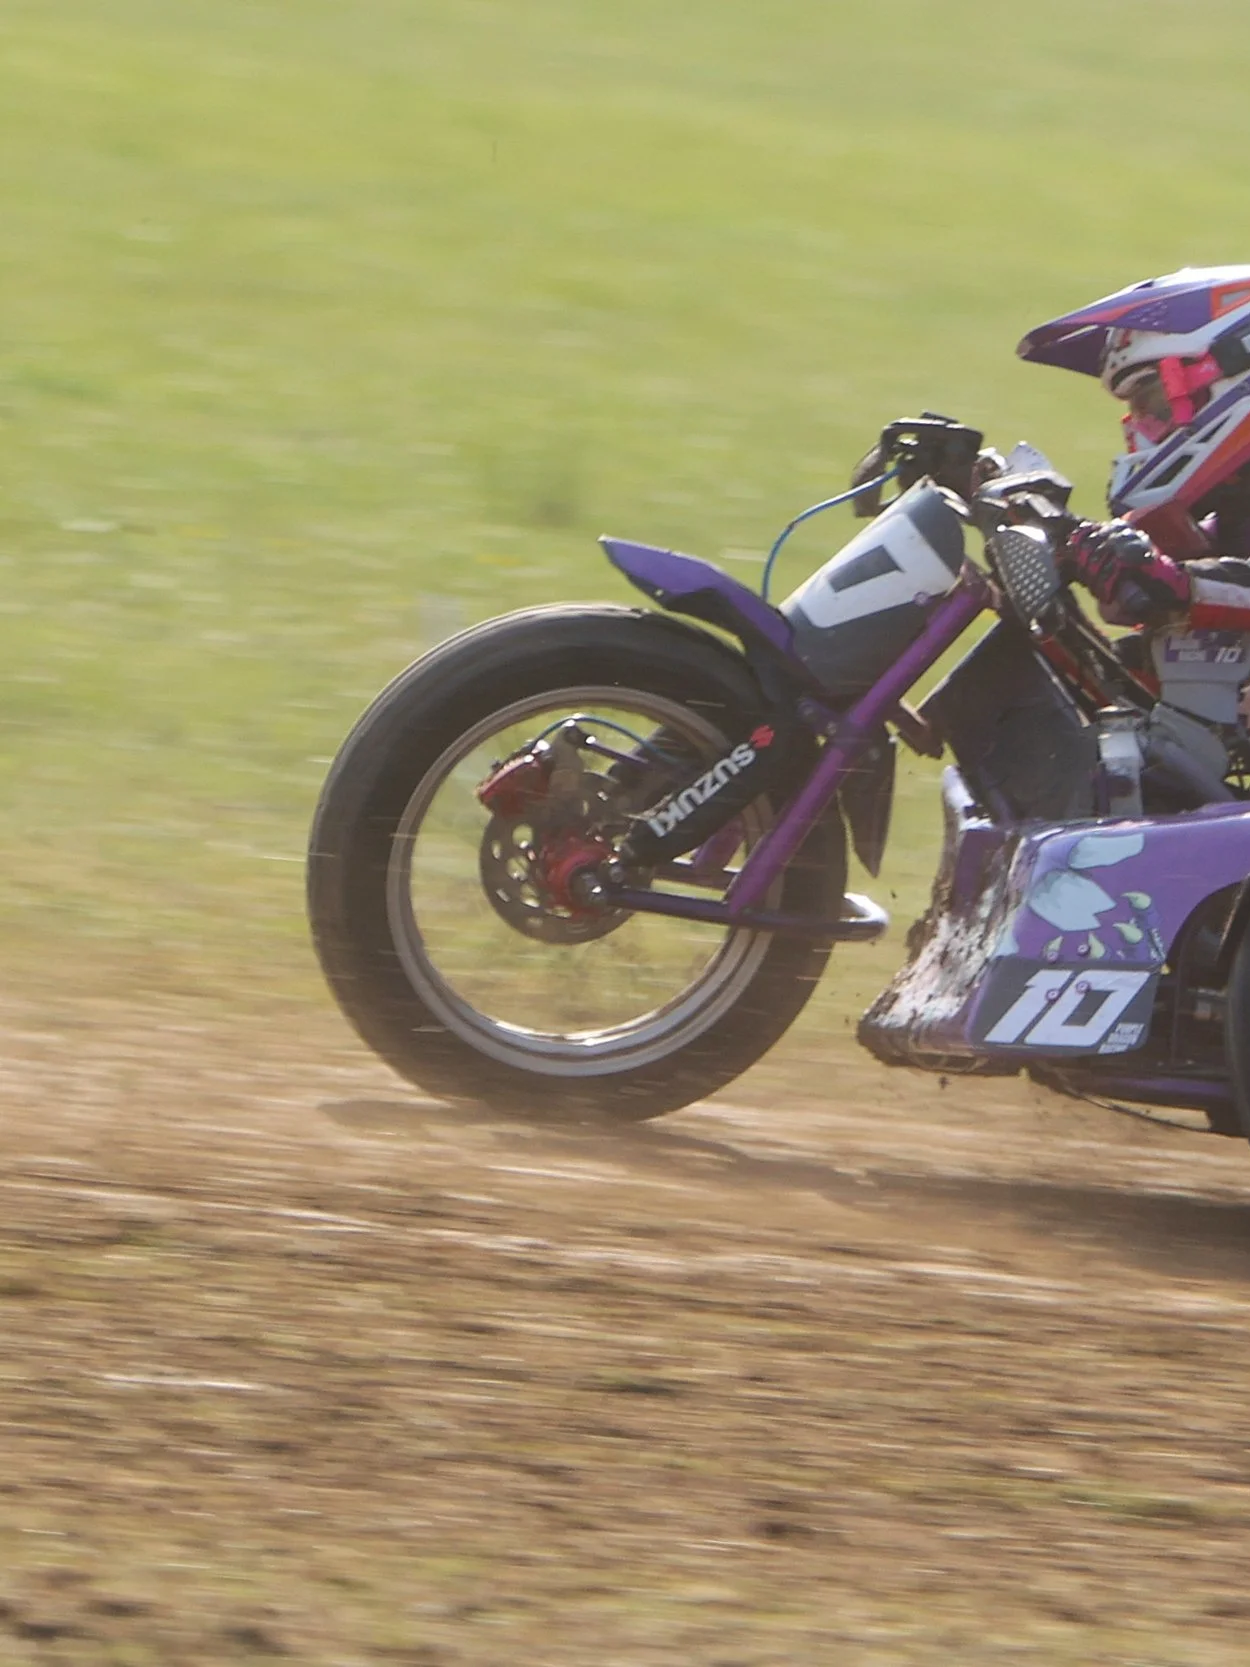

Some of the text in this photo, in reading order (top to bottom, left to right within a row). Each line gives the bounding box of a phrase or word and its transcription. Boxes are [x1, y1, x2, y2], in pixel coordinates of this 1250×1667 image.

[1214, 646, 1242, 664] 10
[648, 743, 757, 838] SUZUKI
[983, 968, 1151, 1047] 10
